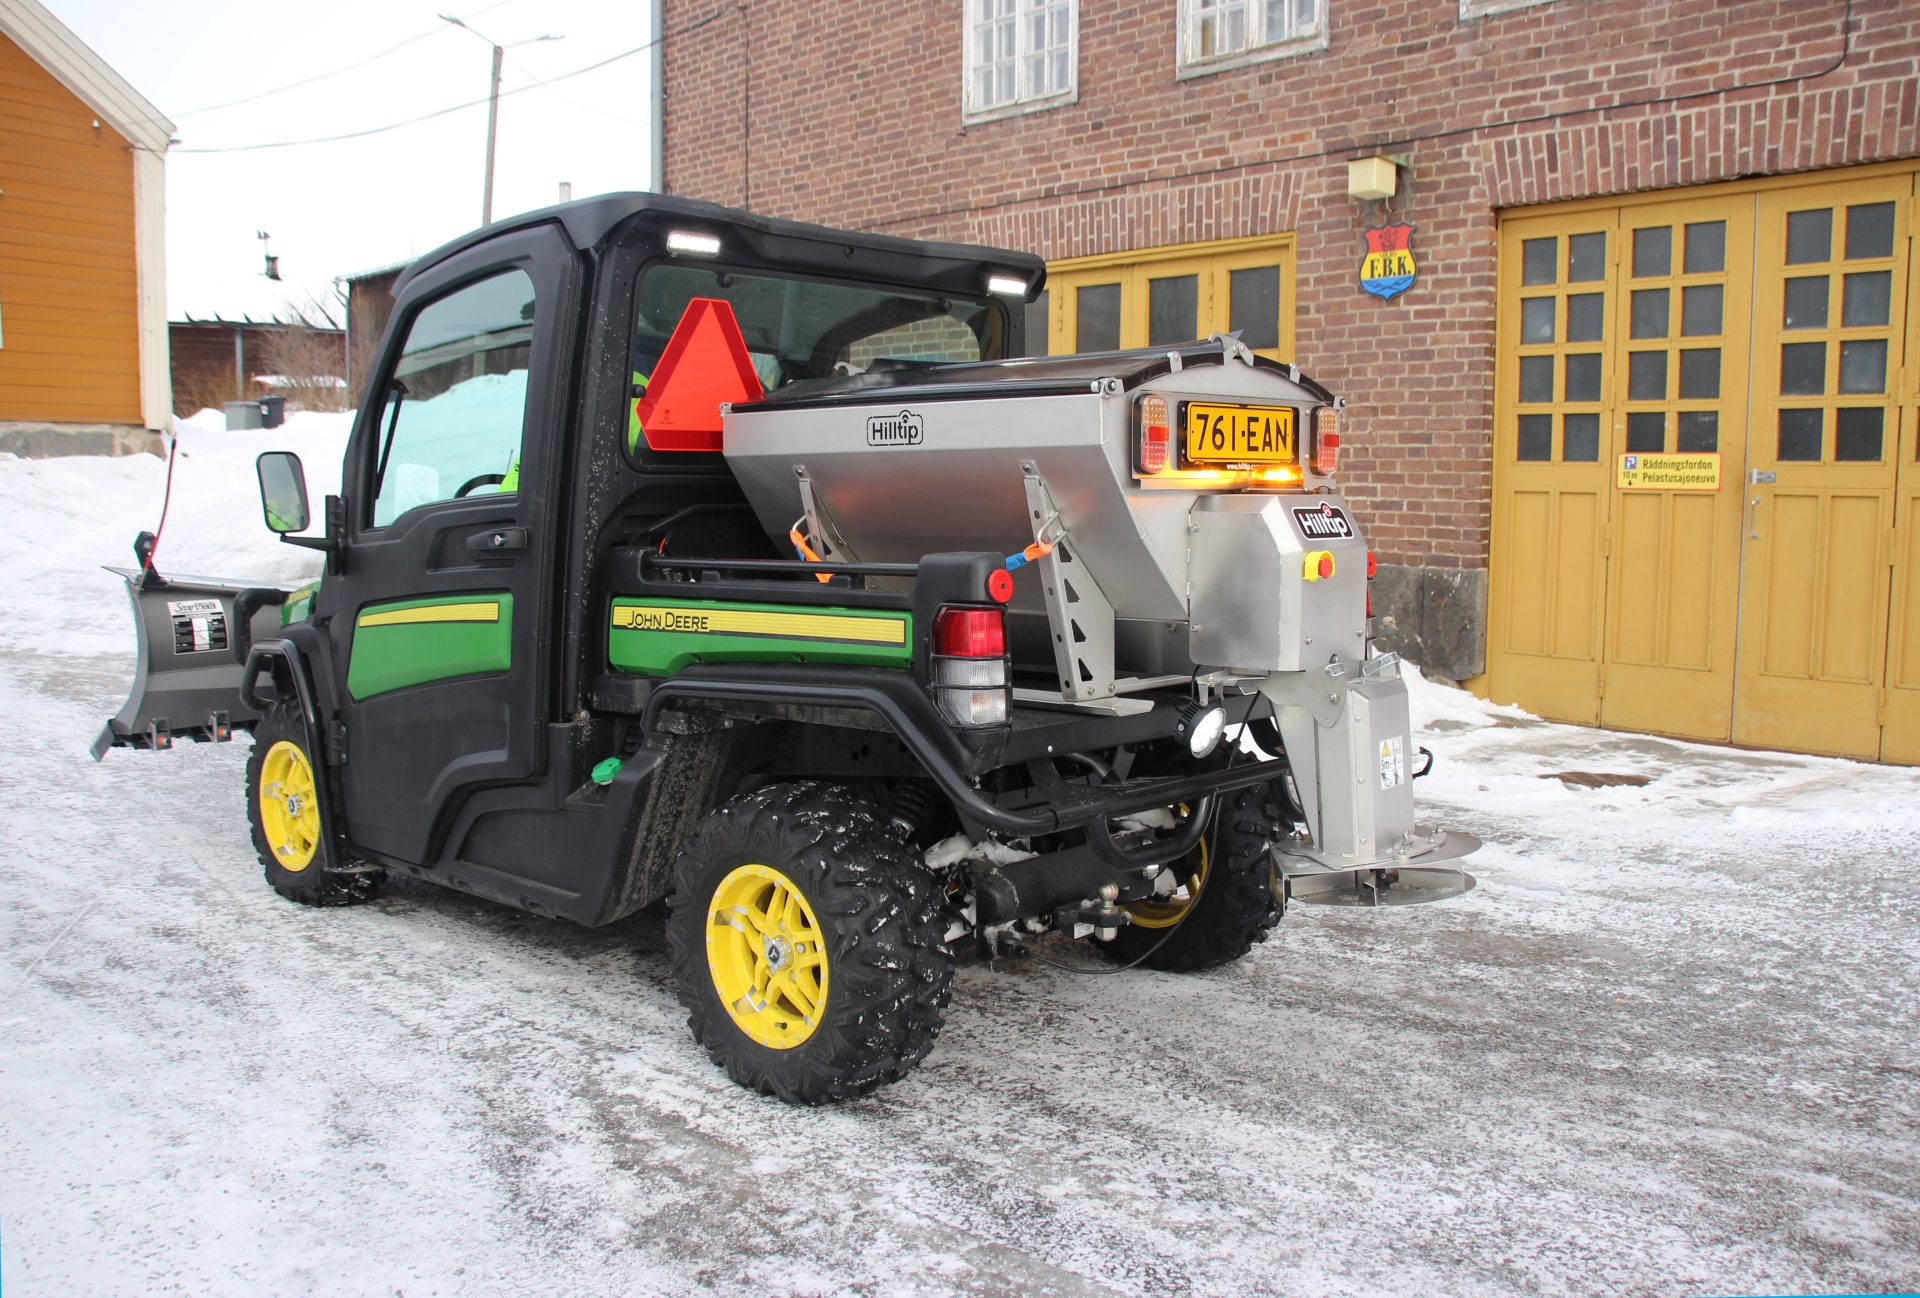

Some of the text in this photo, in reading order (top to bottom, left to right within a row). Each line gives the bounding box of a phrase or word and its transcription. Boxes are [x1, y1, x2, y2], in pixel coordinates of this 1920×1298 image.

[1370, 255, 1411, 278] F.B.K.
[872, 421, 919, 445] Hilltip
[1196, 413, 1288, 453] 761-EAN
[1643, 459, 1712, 471] Räddningsfordon
[1643, 473, 1715, 485] Pelastusajoneuvo
[1297, 513, 1348, 537] Hilltip
[627, 610, 709, 630] JOHN DEERE
